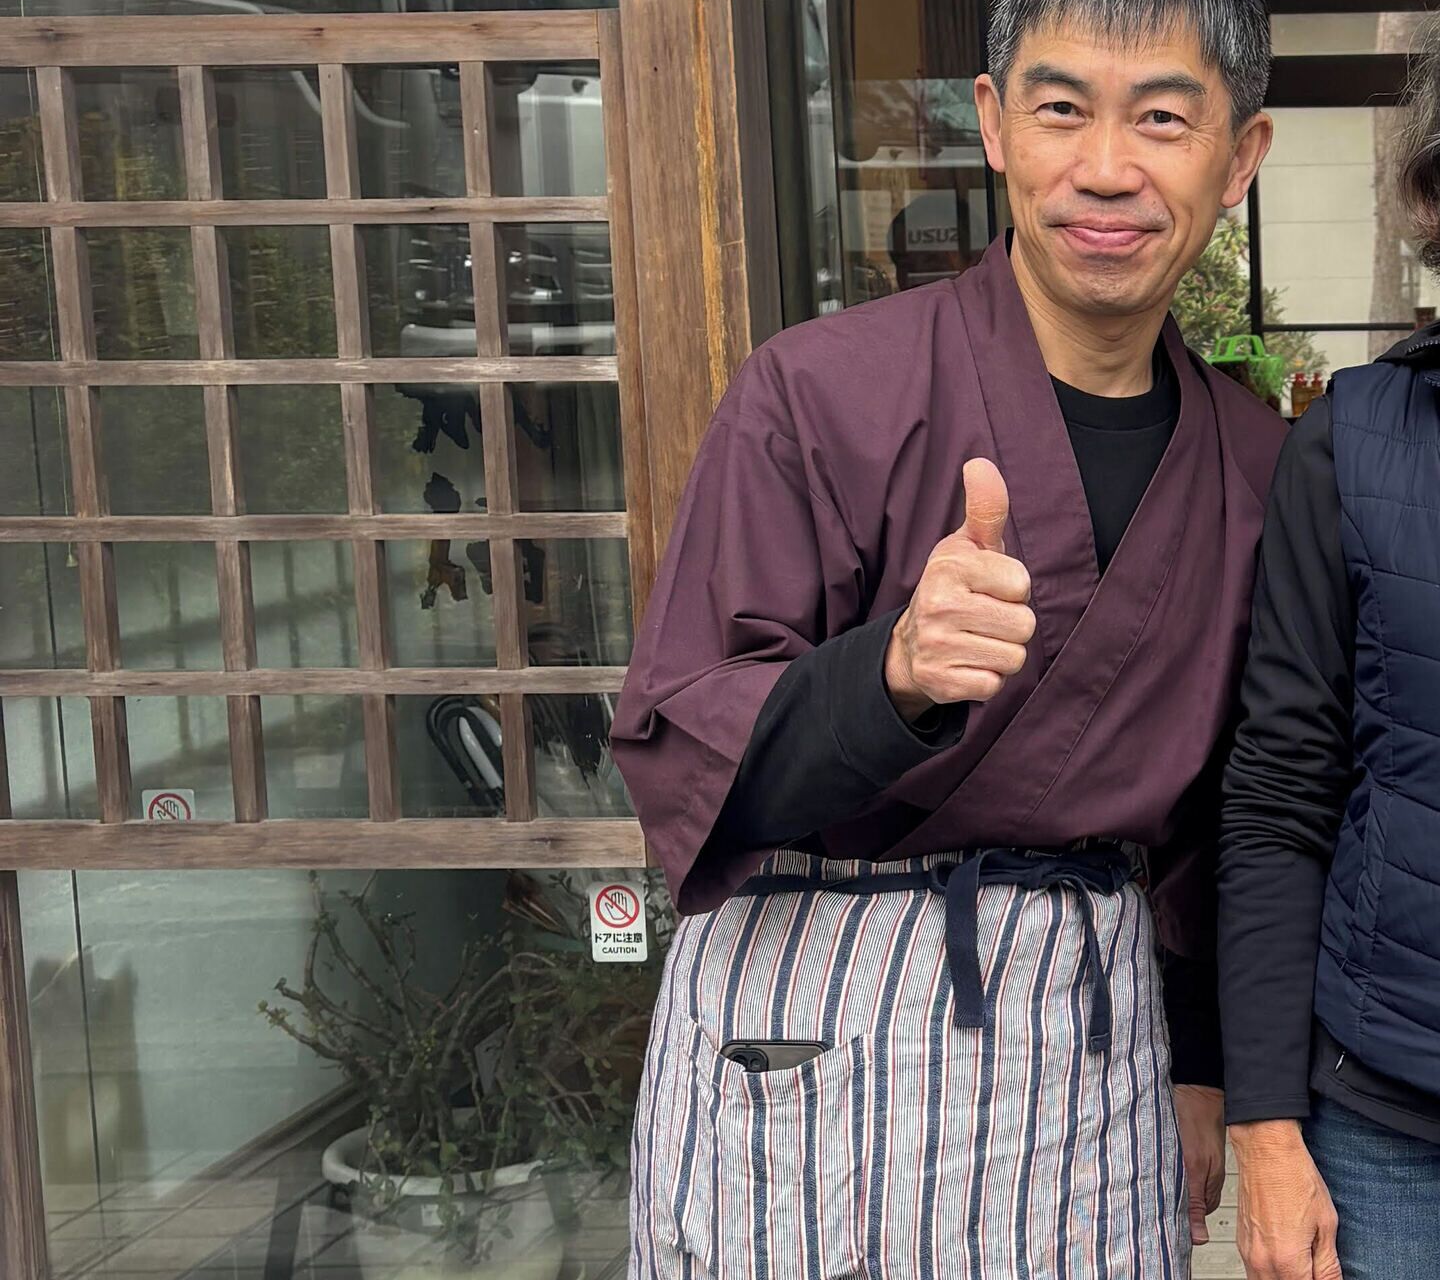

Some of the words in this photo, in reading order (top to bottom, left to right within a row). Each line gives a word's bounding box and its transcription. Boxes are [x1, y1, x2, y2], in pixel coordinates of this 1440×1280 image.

[595, 932, 643, 943] ドアに注意
[602, 946, 637, 954] CAUTION
